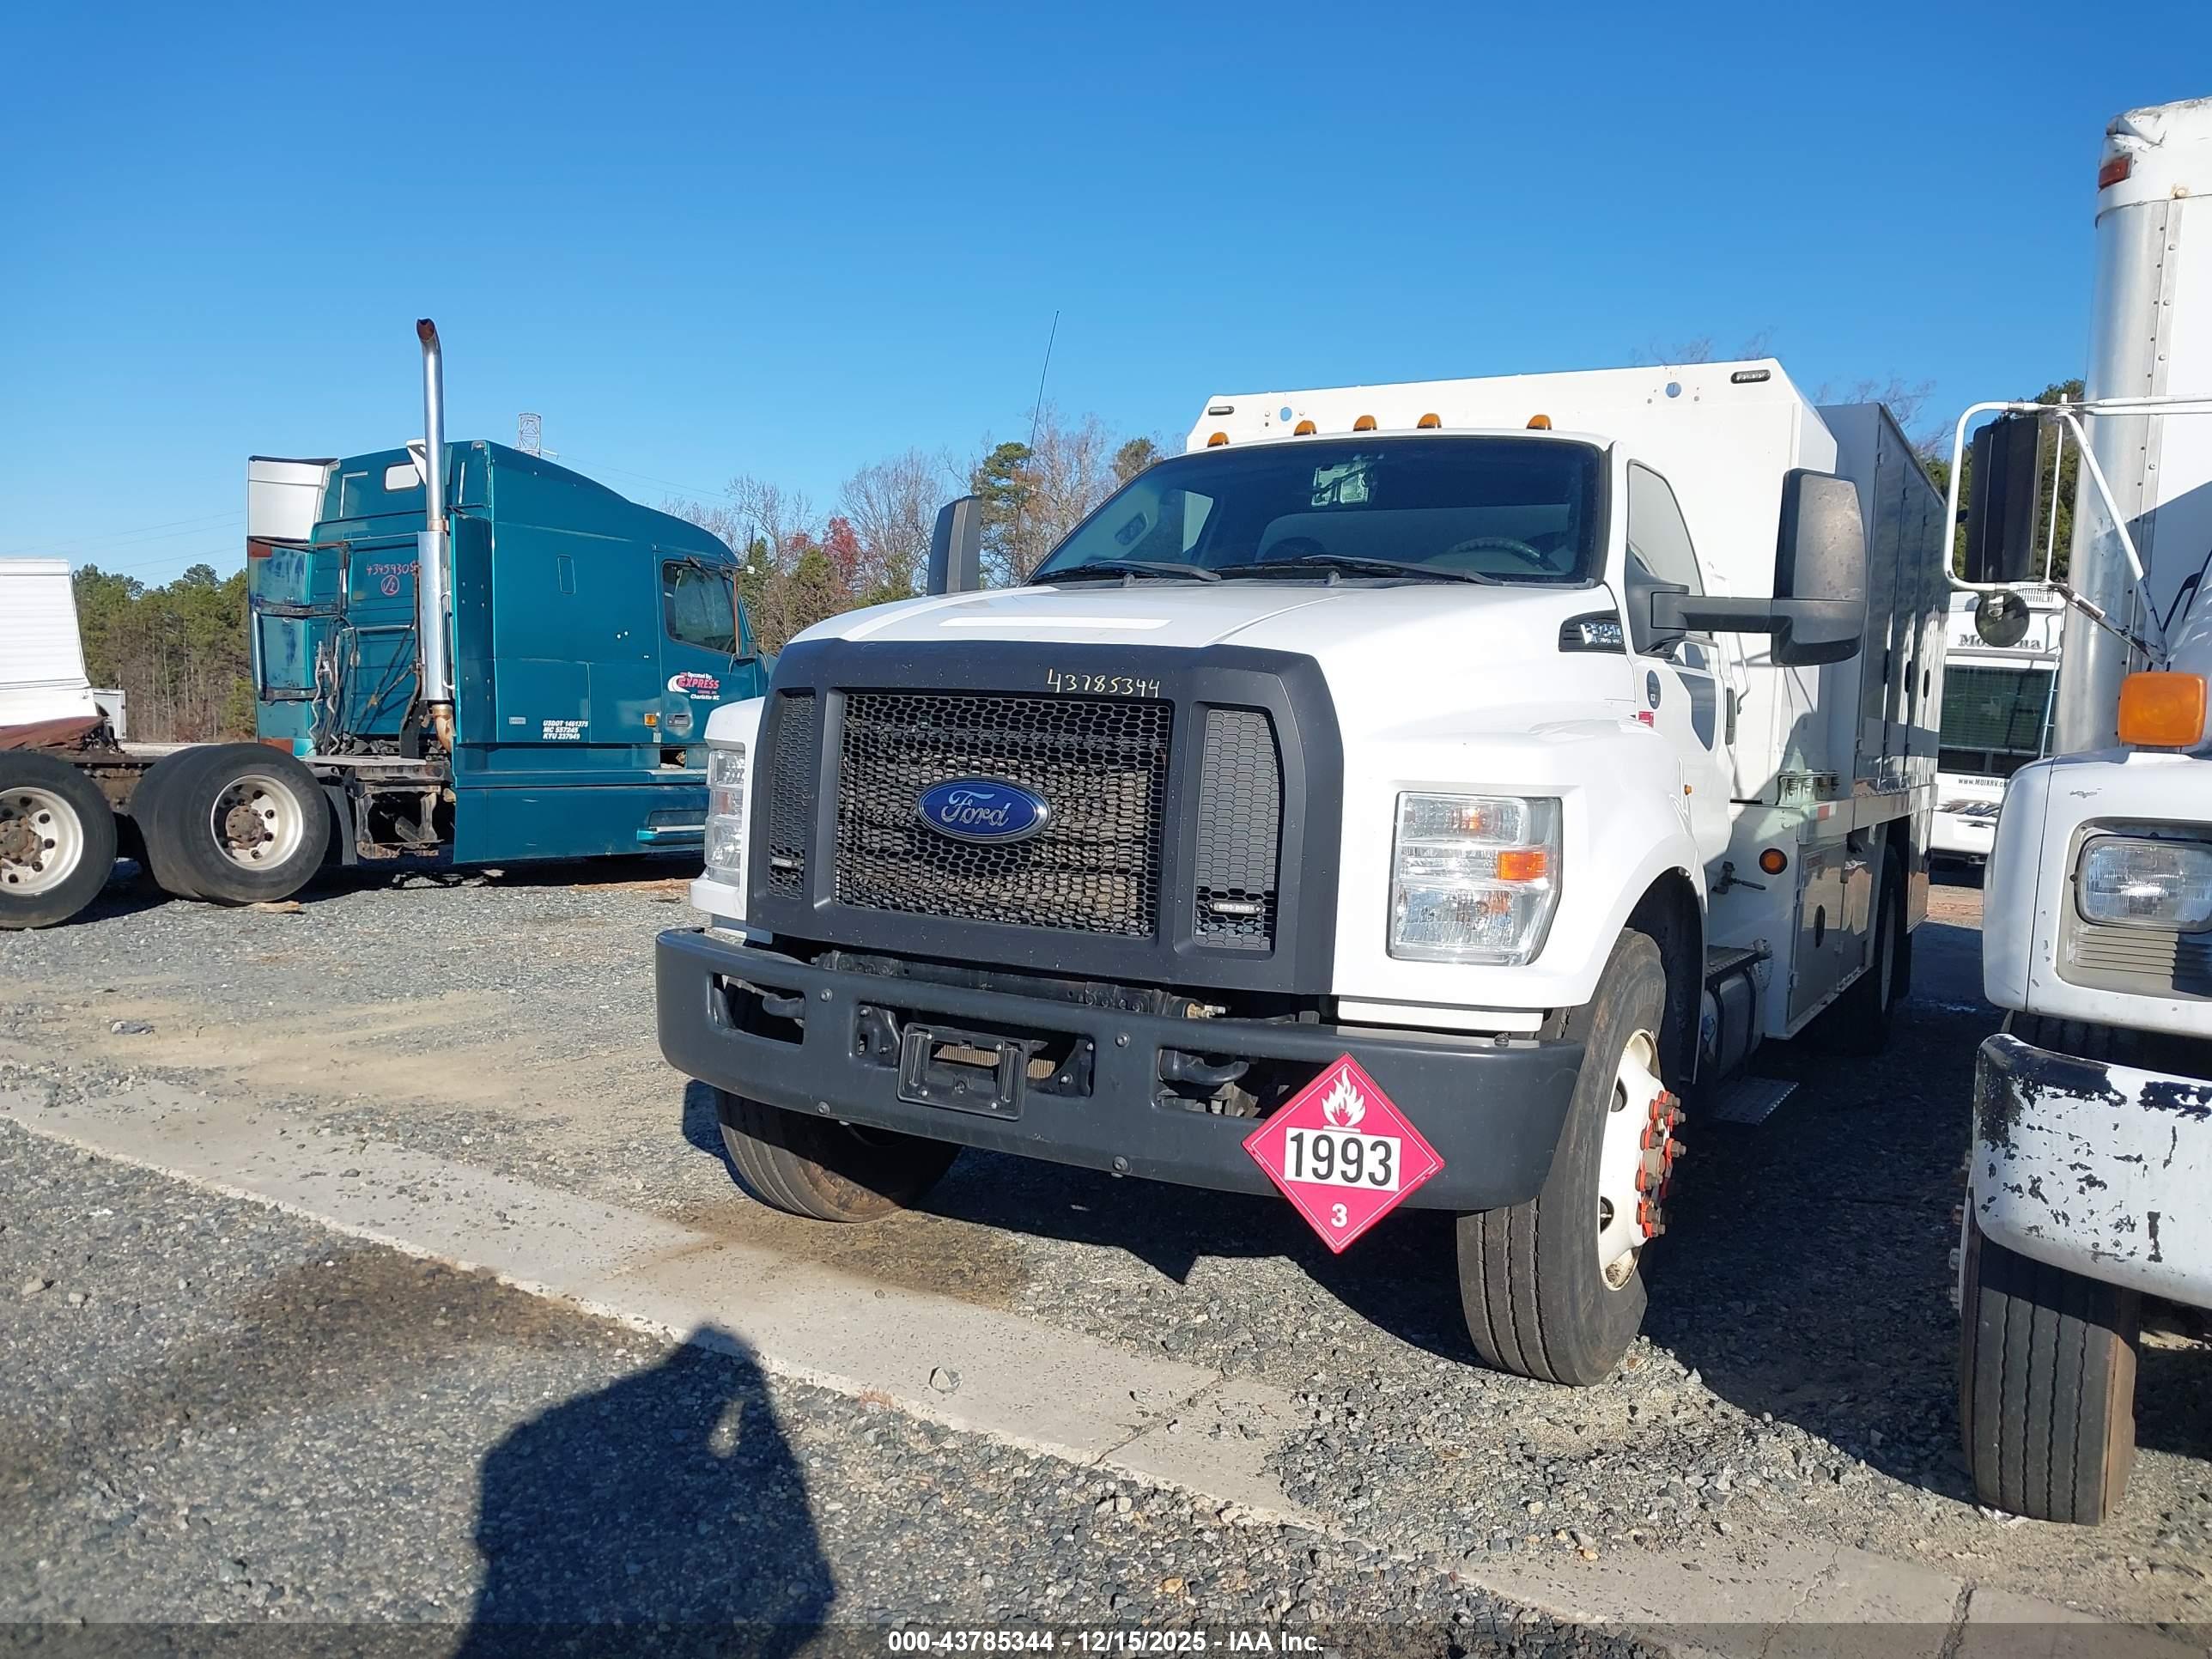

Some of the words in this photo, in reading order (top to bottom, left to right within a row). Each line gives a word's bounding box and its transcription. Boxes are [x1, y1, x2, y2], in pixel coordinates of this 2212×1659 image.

[1958, 634, 2041, 649] Mona
[678, 678, 720, 689] EXPRESS
[1047, 668, 1160, 698] 43785344
[940, 790, 1012, 827] Ford
[1290, 1132, 1392, 1187] 1993
[1330, 1202, 1348, 1228] 3
